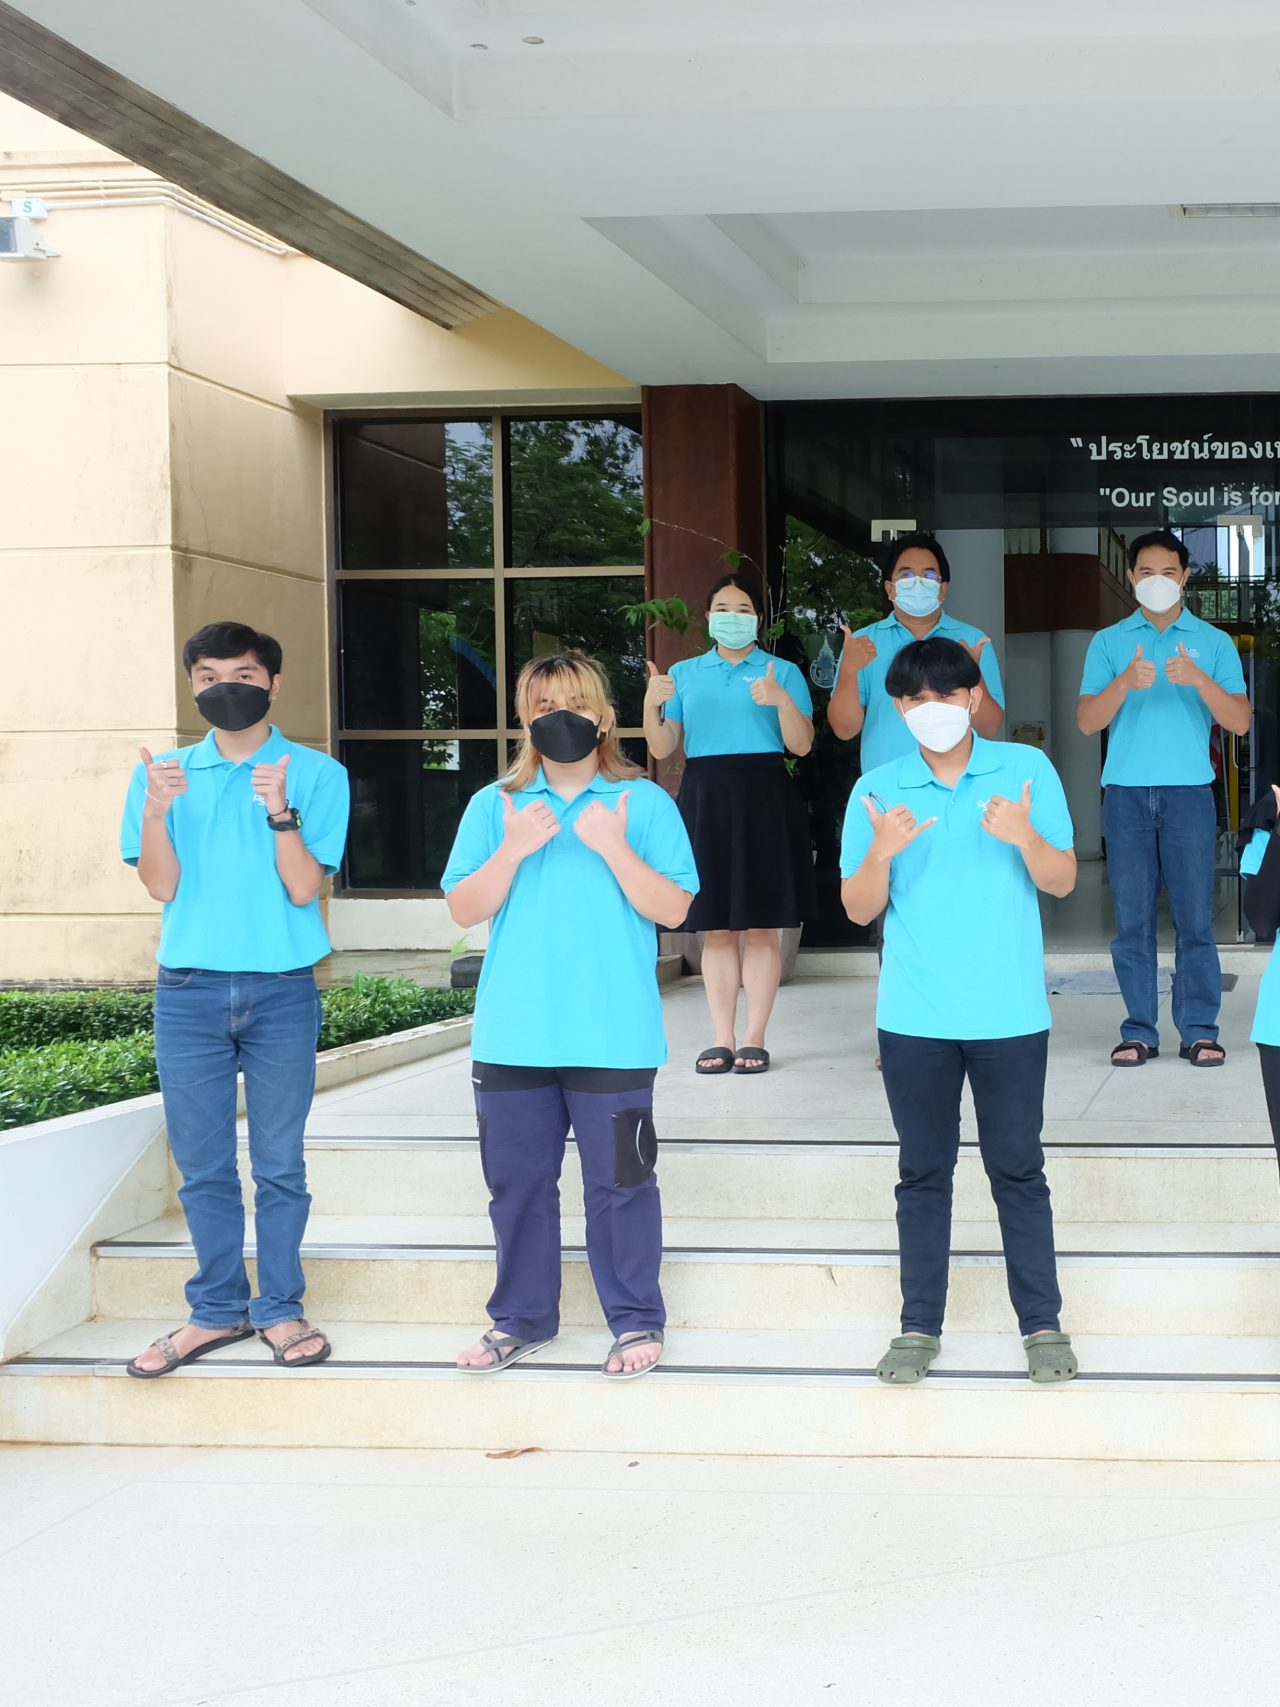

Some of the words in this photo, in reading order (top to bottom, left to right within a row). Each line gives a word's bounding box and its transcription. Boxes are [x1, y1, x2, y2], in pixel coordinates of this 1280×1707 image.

[23, 200, 32, 213] S
[1100, 486, 1155, 508] "Our
[1162, 485, 1215, 507] Soul
[1223, 485, 1243, 507] is
